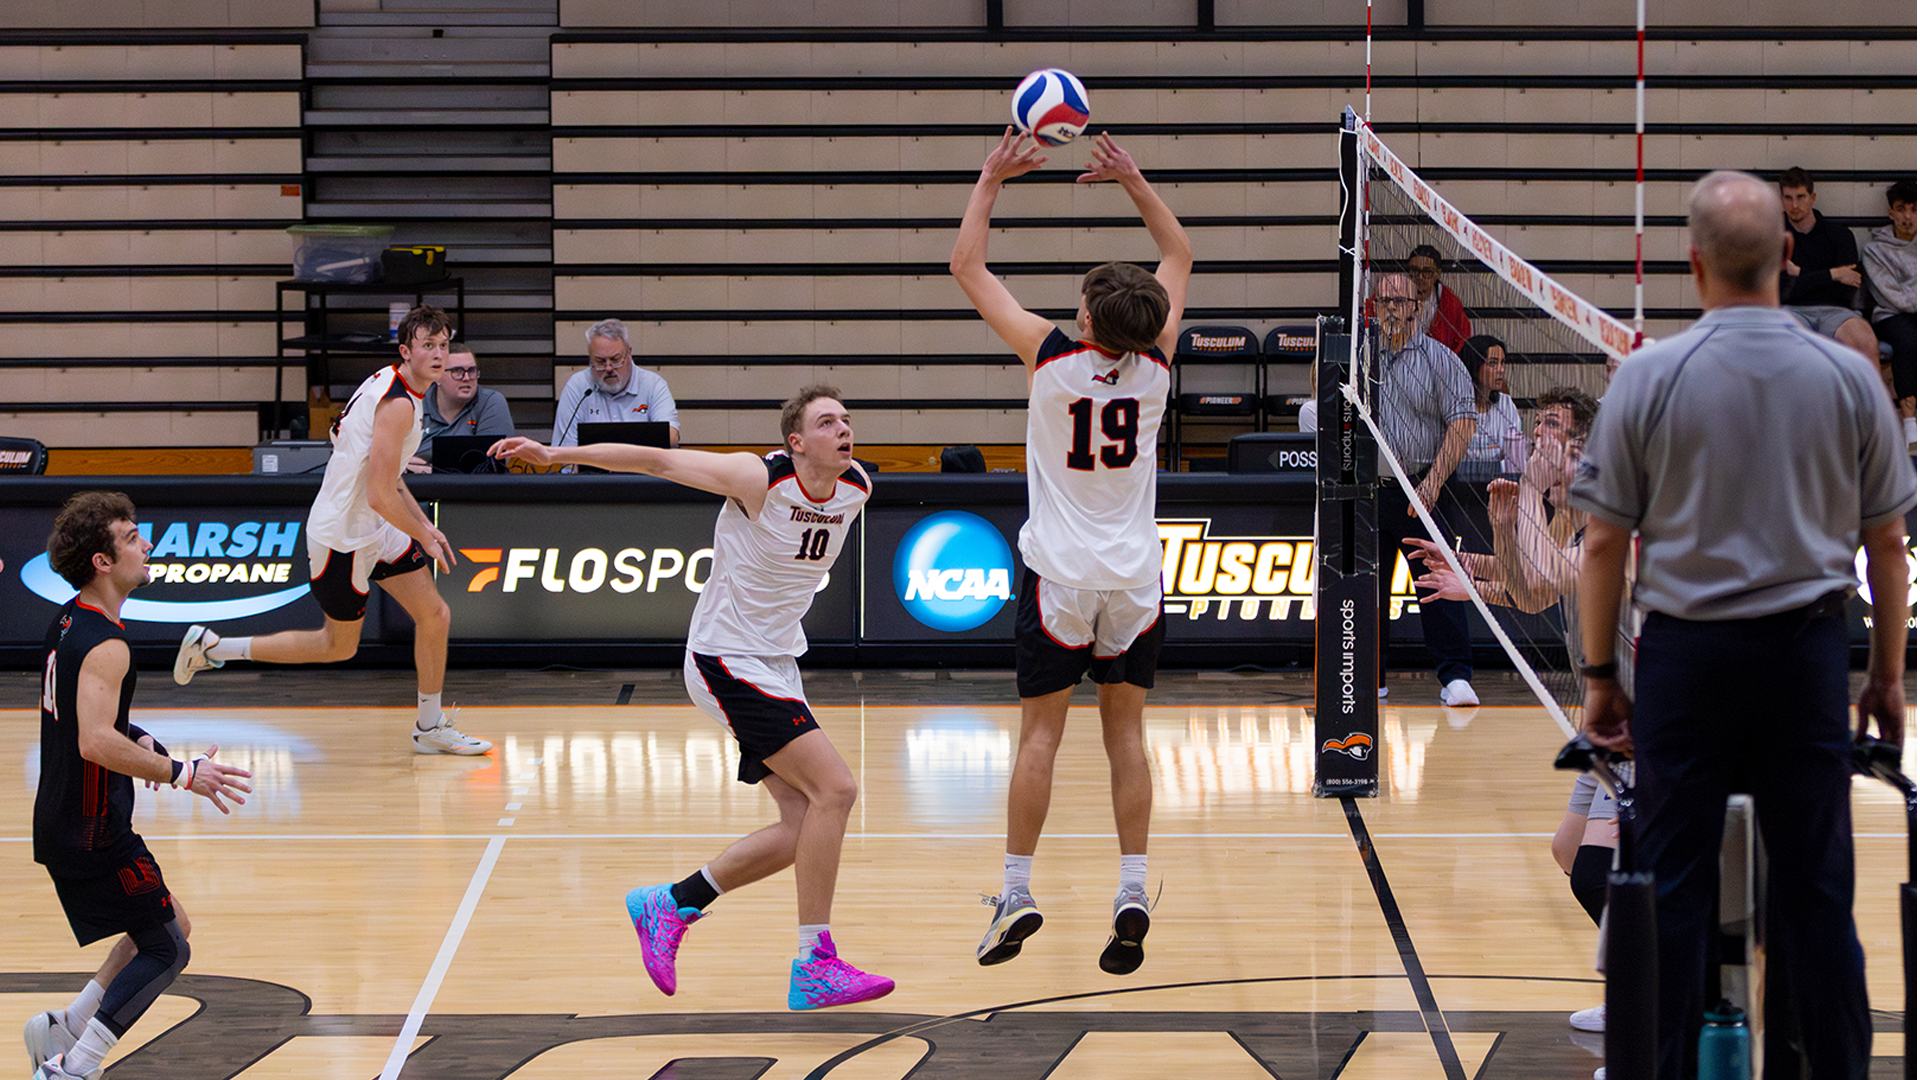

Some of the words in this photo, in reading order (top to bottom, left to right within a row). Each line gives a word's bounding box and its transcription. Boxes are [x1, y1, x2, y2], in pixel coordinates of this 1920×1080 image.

[1190, 333, 1246, 348] TUSCULUM
[1277, 333, 1317, 347] TUSCUL
[1066, 397, 1140, 471] 19
[0, 451, 33, 464] CULUM
[794, 527, 830, 561] 10
[149, 563, 292, 583] PROPANE
[502, 547, 830, 593] FLOSPO
[904, 568, 1010, 601] NCAA
[1340, 599, 1356, 649] sports
[1340, 652, 1356, 714] imports
